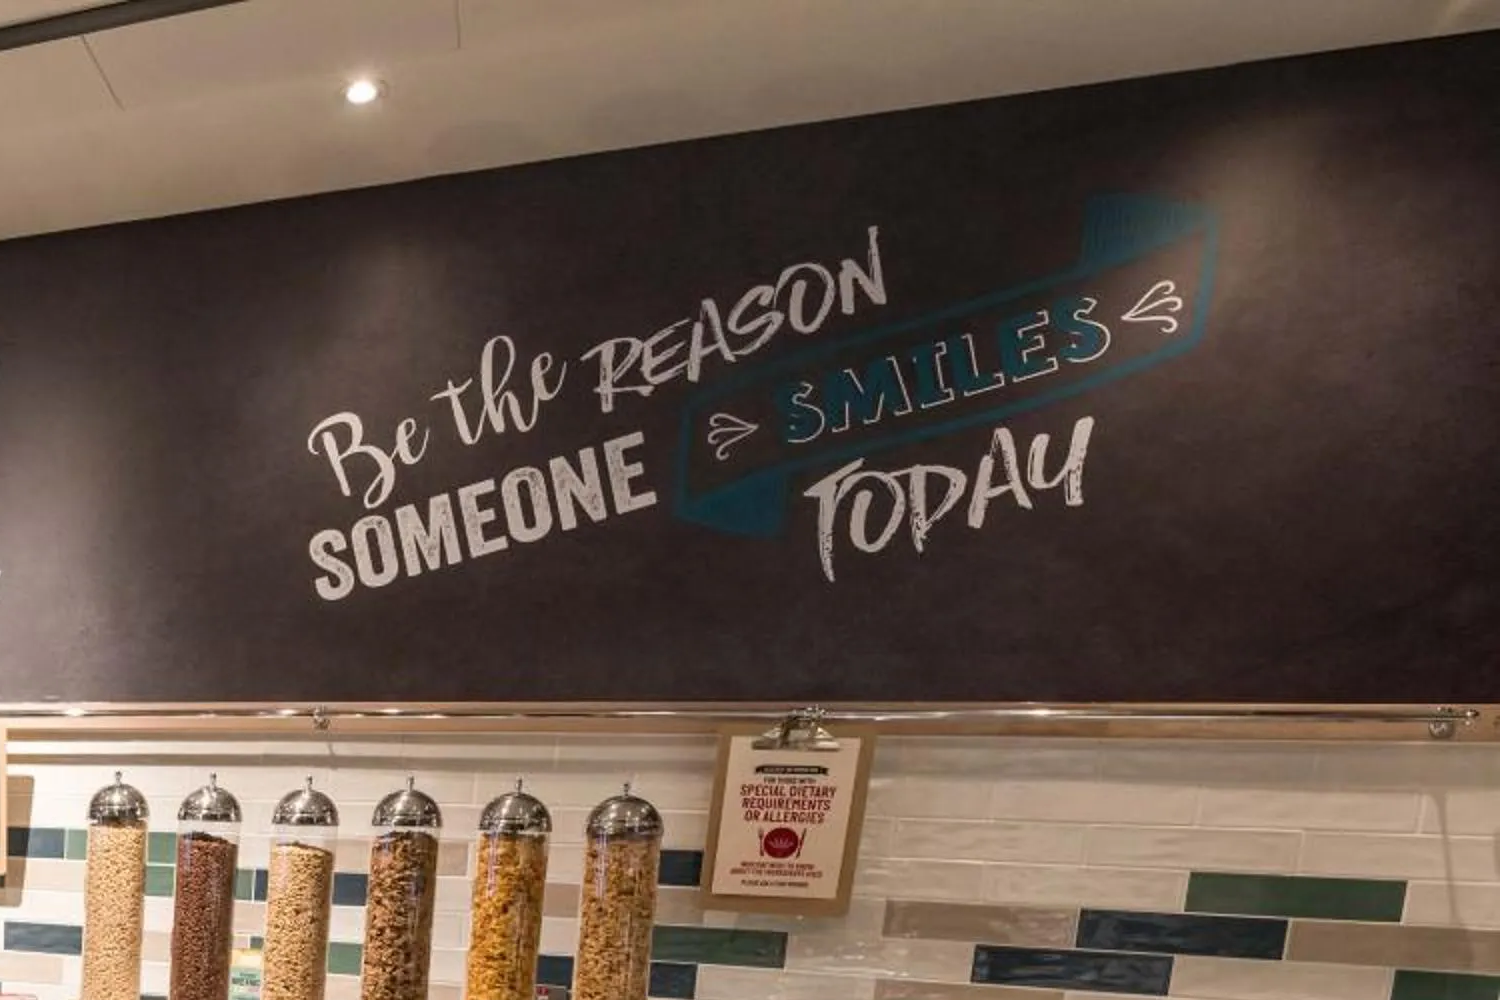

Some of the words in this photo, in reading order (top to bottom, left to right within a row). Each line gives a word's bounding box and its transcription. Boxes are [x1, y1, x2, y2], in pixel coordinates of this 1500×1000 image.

[308, 411, 430, 509] Be
[429, 335, 568, 446] the
[580, 225, 887, 413] REASON
[776, 296, 1112, 444] SMILES
[308, 431, 658, 601] SOMEONE
[740, 783, 787, 797] SPECIAL
[789, 785, 837, 799] DIETARY
[741, 797, 832, 811] REQUIREMENTS
[744, 809, 761, 822] OR
[763, 810, 825, 824] ALLERGIES
